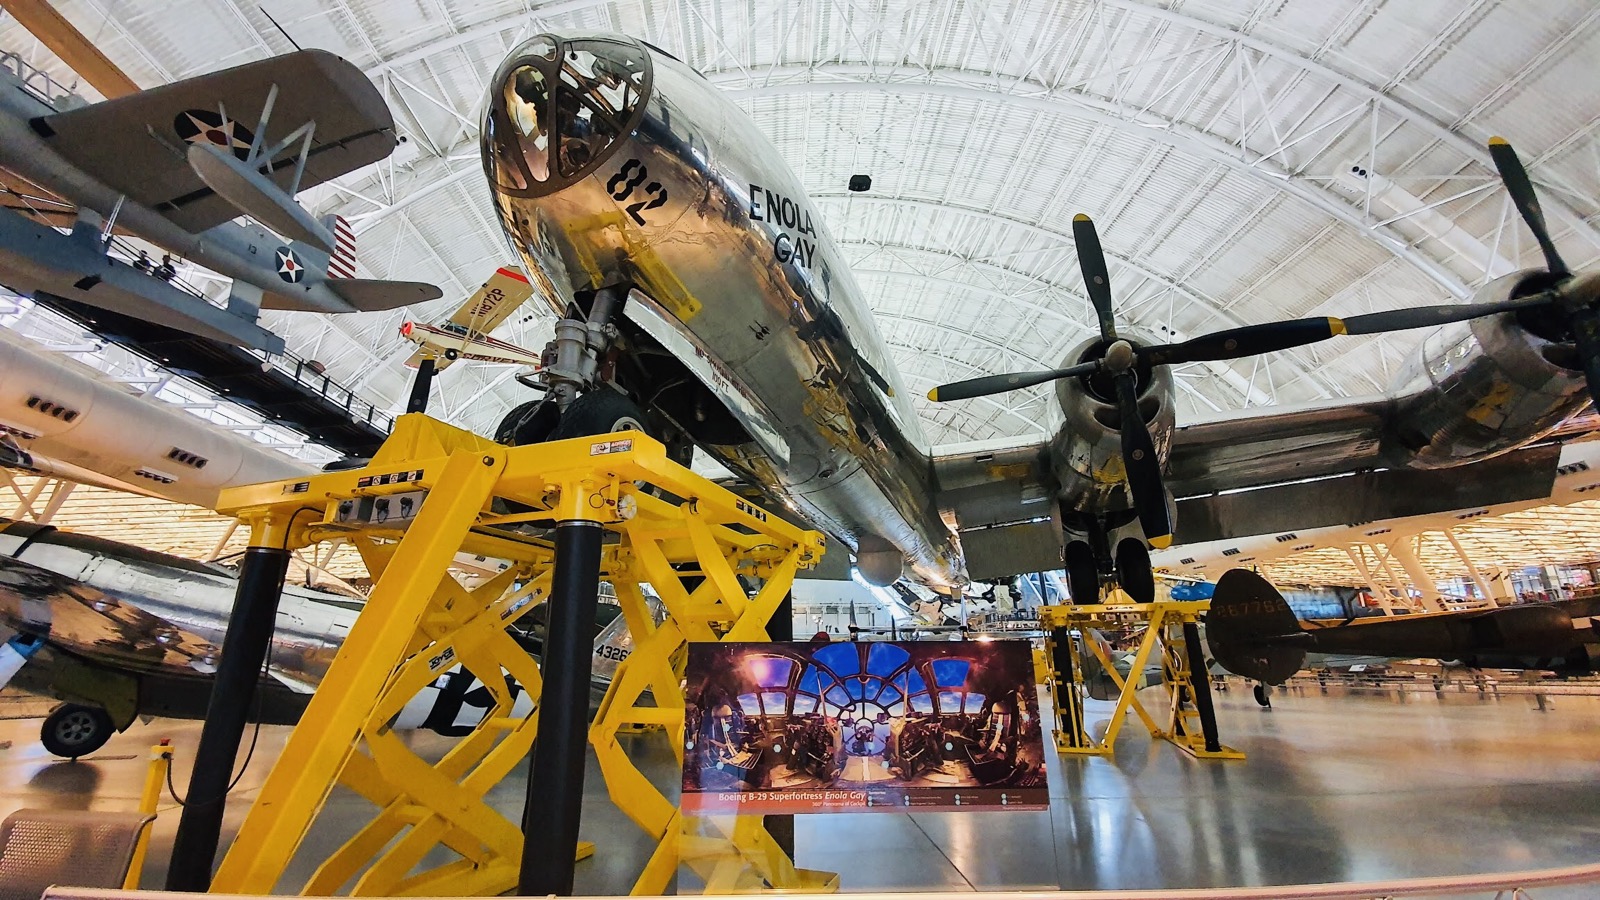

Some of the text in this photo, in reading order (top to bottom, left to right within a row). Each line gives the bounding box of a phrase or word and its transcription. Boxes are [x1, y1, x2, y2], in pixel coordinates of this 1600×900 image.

[606, 158, 668, 227] 82
[749, 183, 817, 239] ENOLA
[774, 233, 816, 269] GAY
[596, 644, 632, 662] 4326
[718, 791, 867, 803] Boeing B-29 Superfortress Enola Gay
